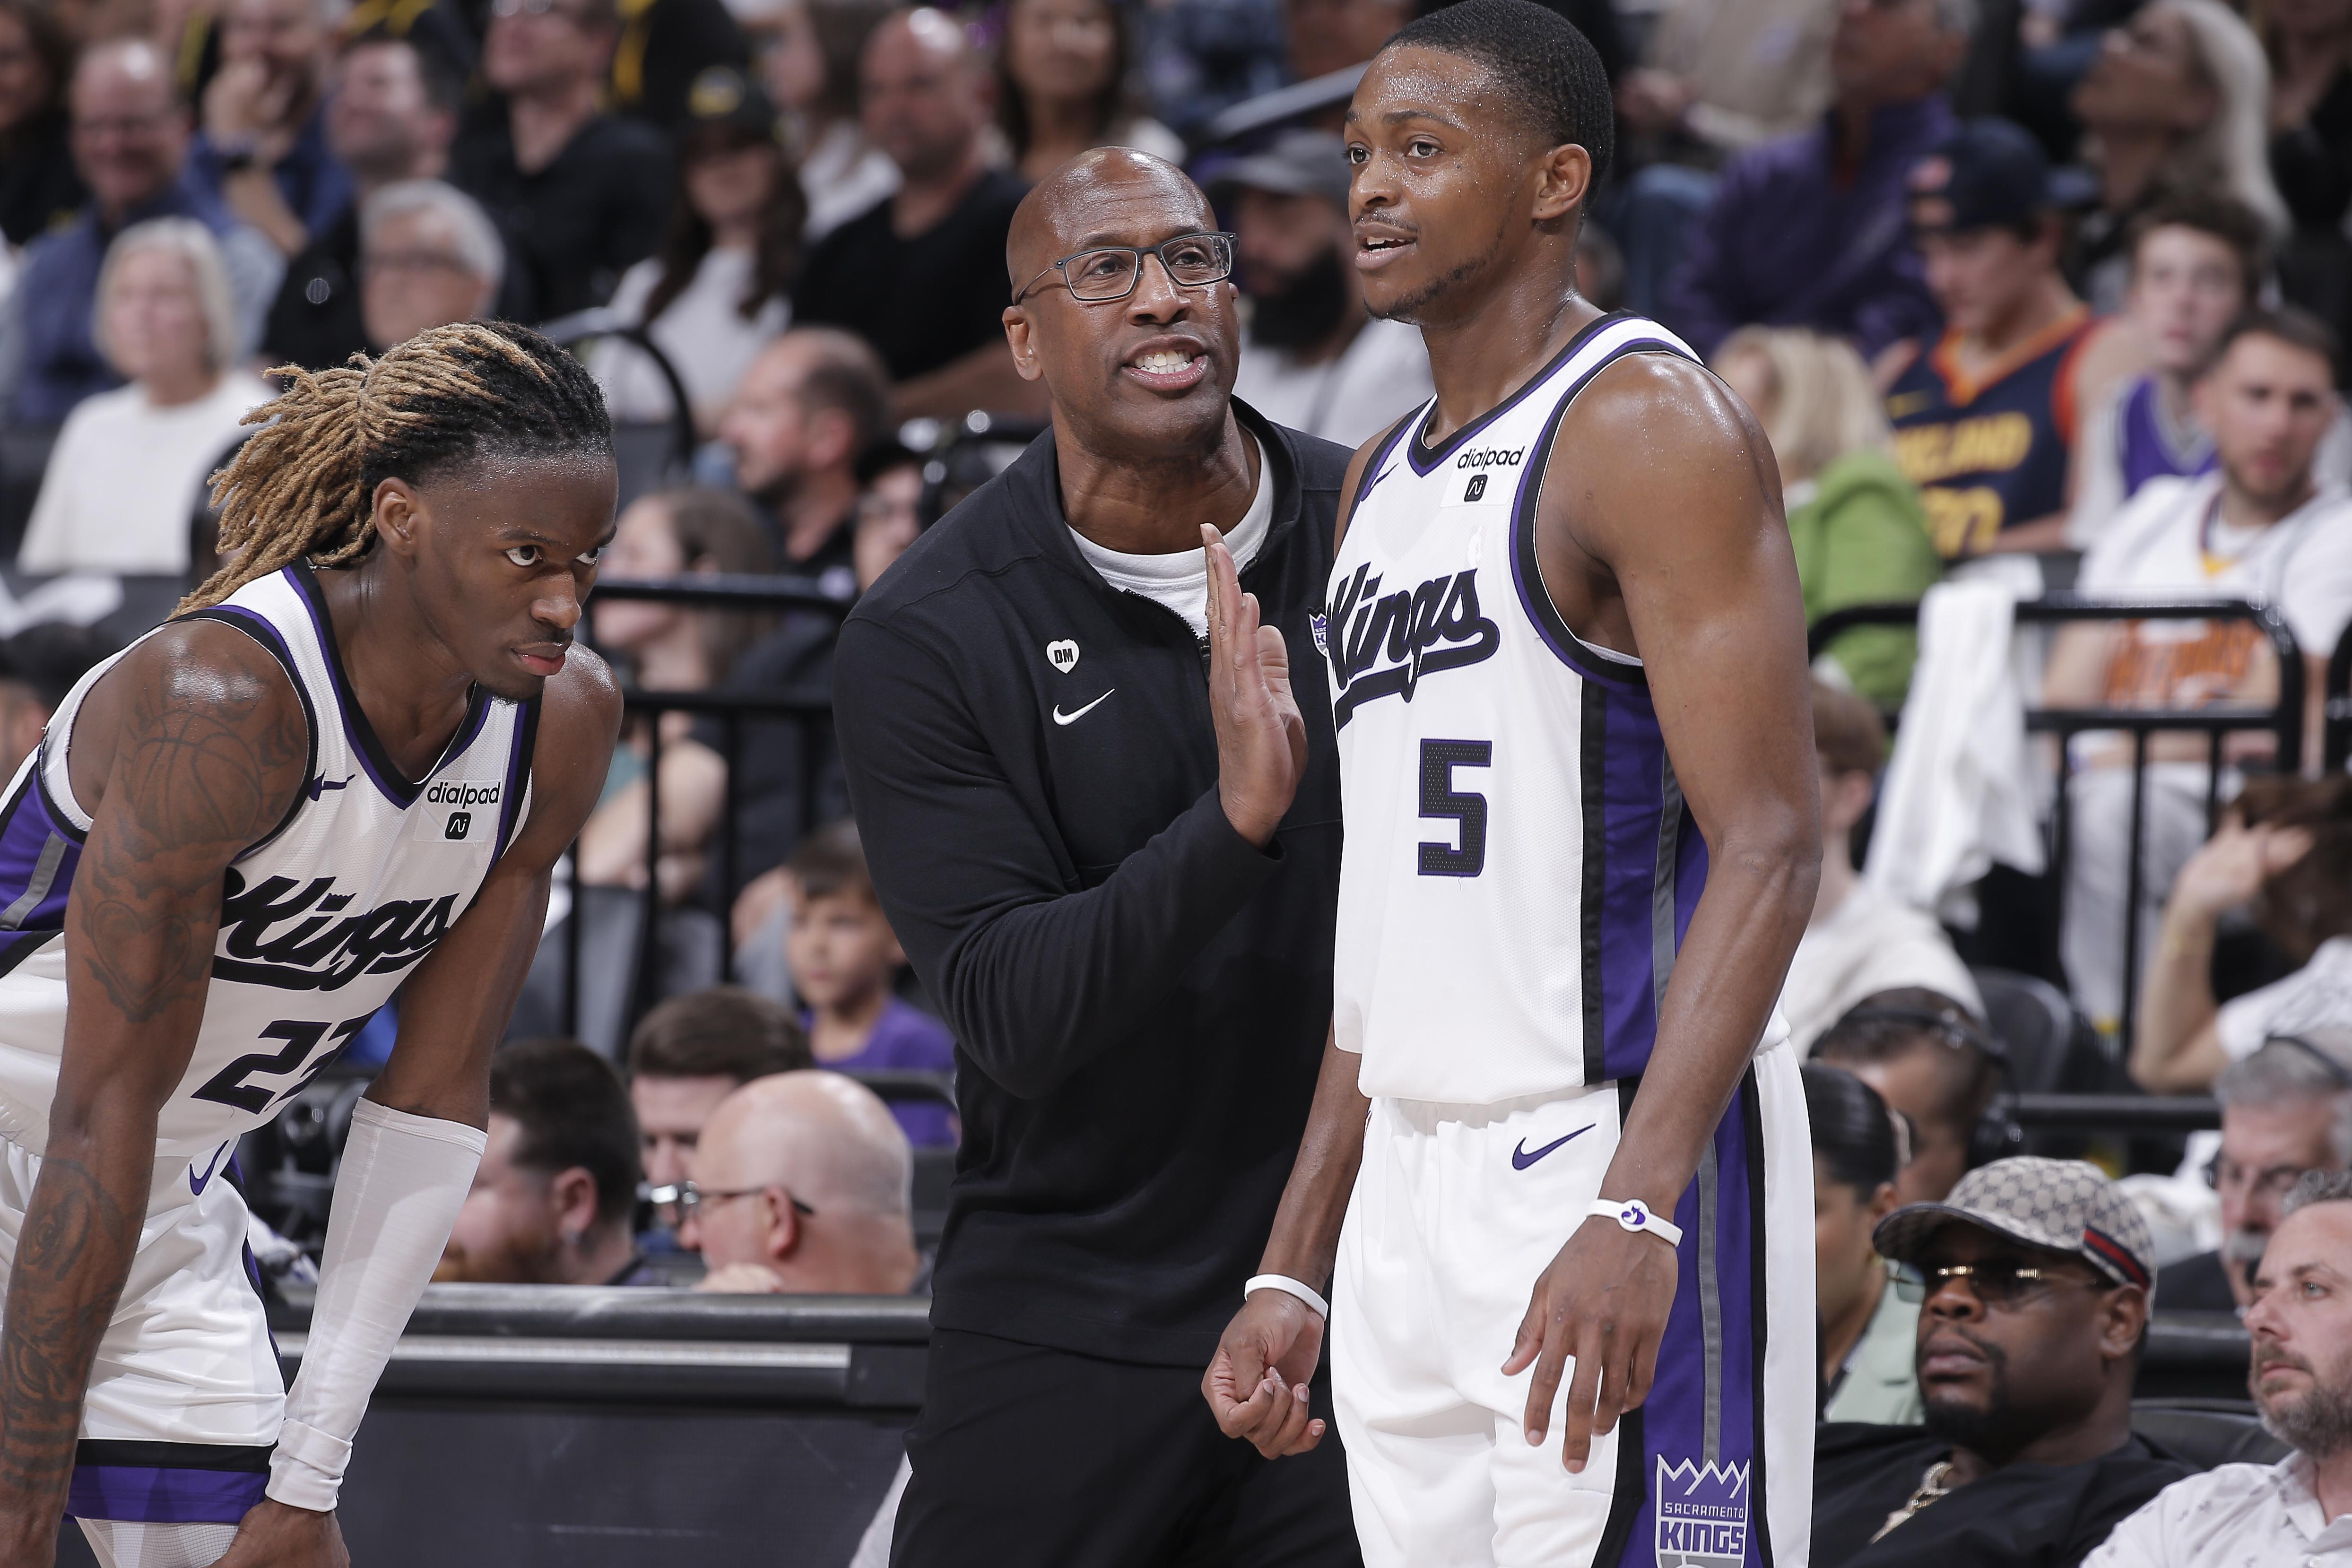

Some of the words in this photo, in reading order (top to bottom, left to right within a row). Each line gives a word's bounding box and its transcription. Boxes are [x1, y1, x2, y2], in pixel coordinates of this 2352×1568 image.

[1458, 446, 1525, 471] dialpad
[1054, 648, 1074, 663] DM
[1326, 561, 1500, 735] Kings
[427, 782, 501, 809] dialpad
[1418, 738, 1492, 876] 5
[1665, 1502, 1744, 1519] SACRAMENTO
[1660, 1521, 1744, 1555] KINGS
